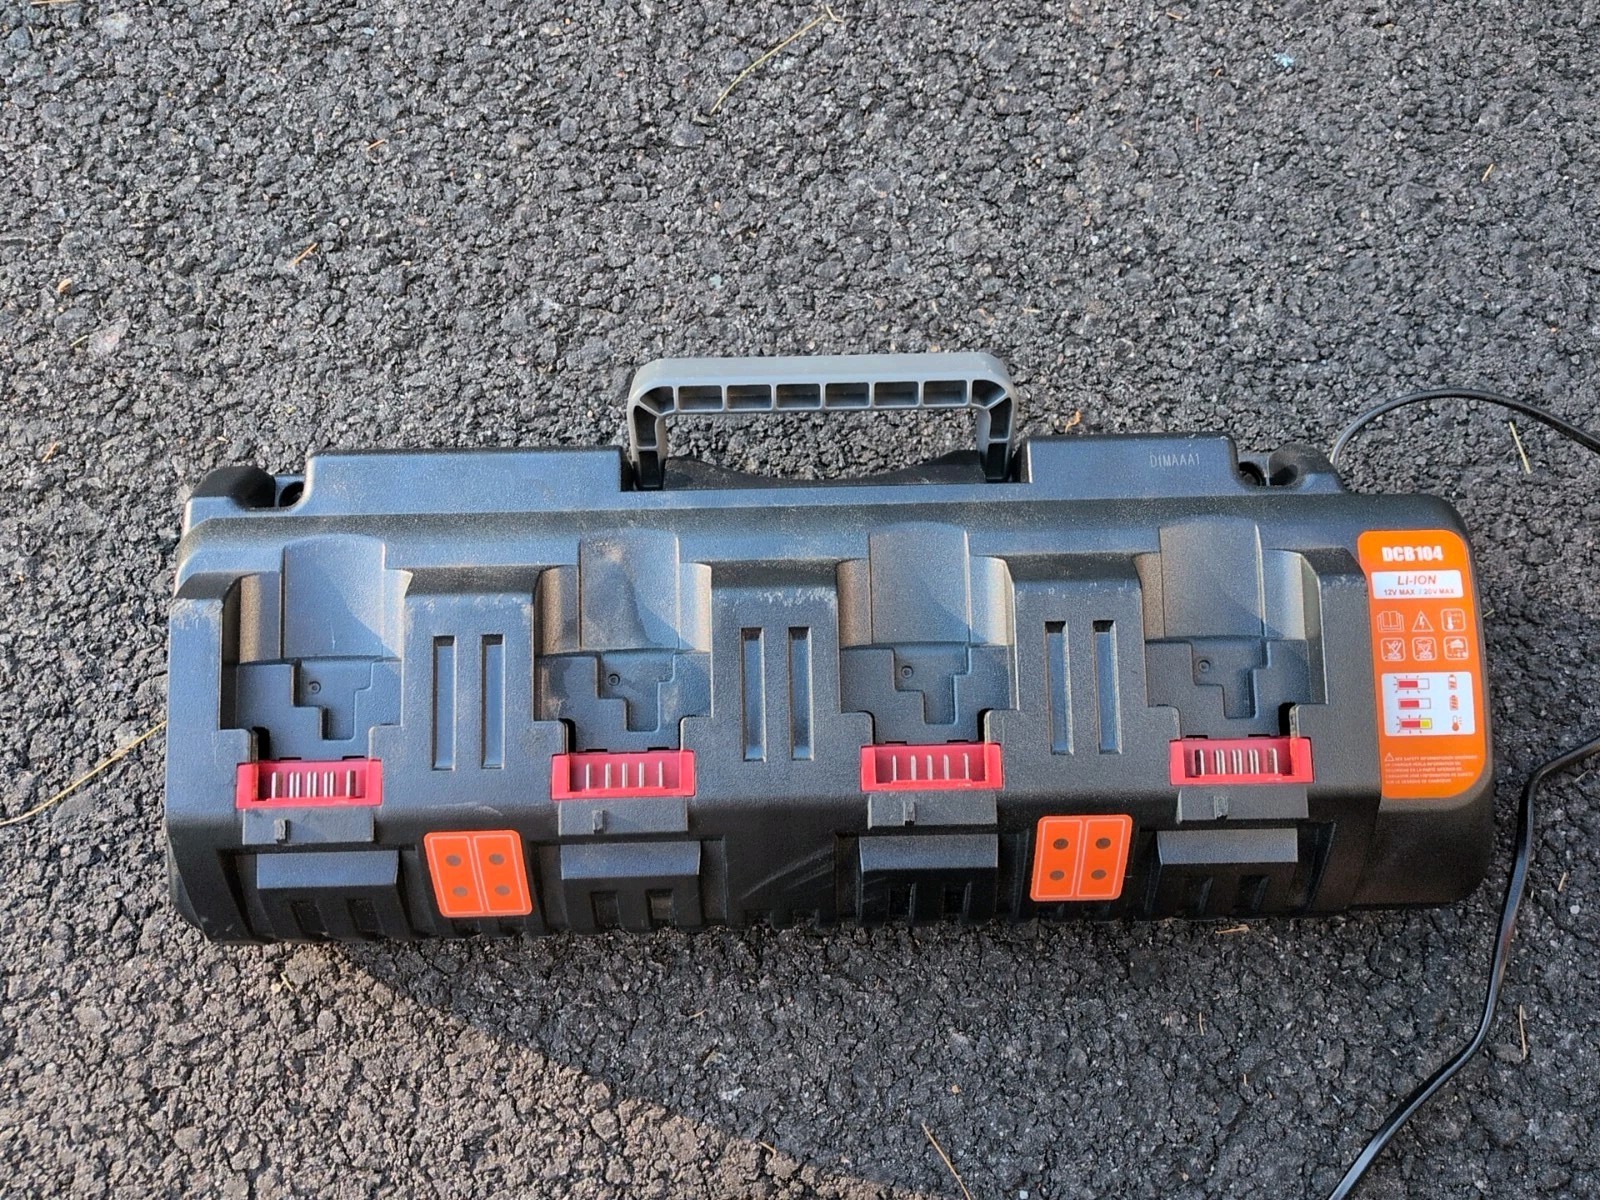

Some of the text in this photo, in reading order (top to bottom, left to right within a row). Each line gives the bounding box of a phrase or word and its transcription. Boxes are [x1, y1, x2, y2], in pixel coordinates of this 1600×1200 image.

[1381, 546, 1443, 562] DCB104
[1397, 575, 1437, 586] LI-ION
[1400, 588, 1415, 596] MAX
